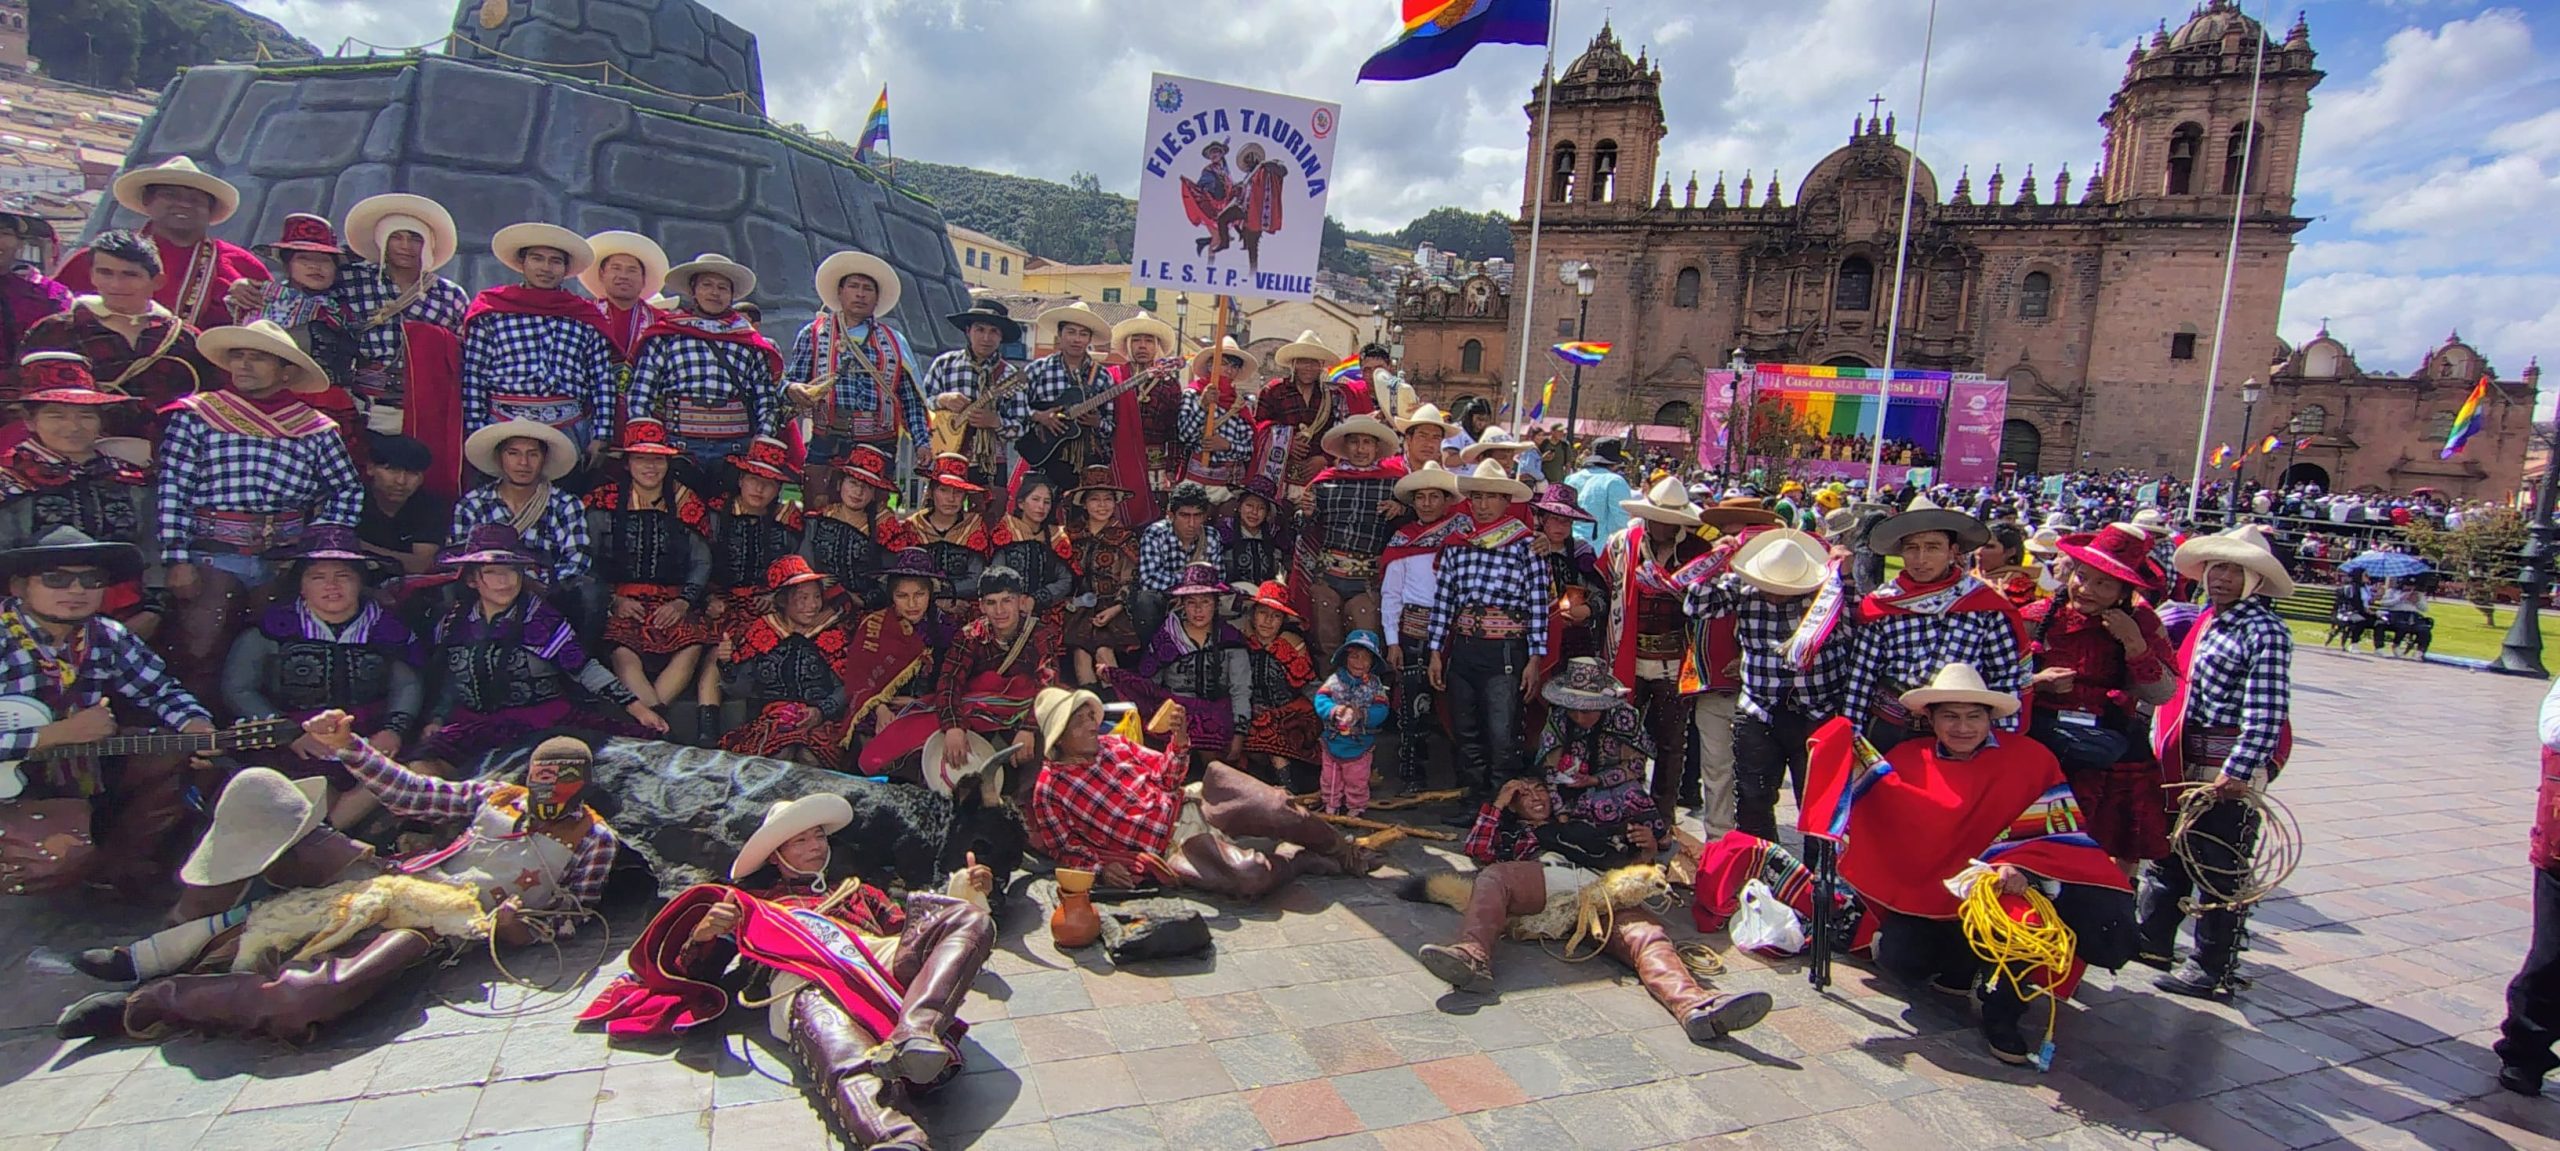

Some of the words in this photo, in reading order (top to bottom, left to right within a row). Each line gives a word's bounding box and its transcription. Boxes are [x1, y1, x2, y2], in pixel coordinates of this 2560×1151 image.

[1146, 109, 1230, 178] FIESTA
[1240, 109, 1326, 198] TAURINA
[1255, 272, 1313, 294] VELILLE
[1785, 376, 1823, 388] Cusco
[1858, 380, 1873, 390] de
[1878, 381, 1913, 393] esta
